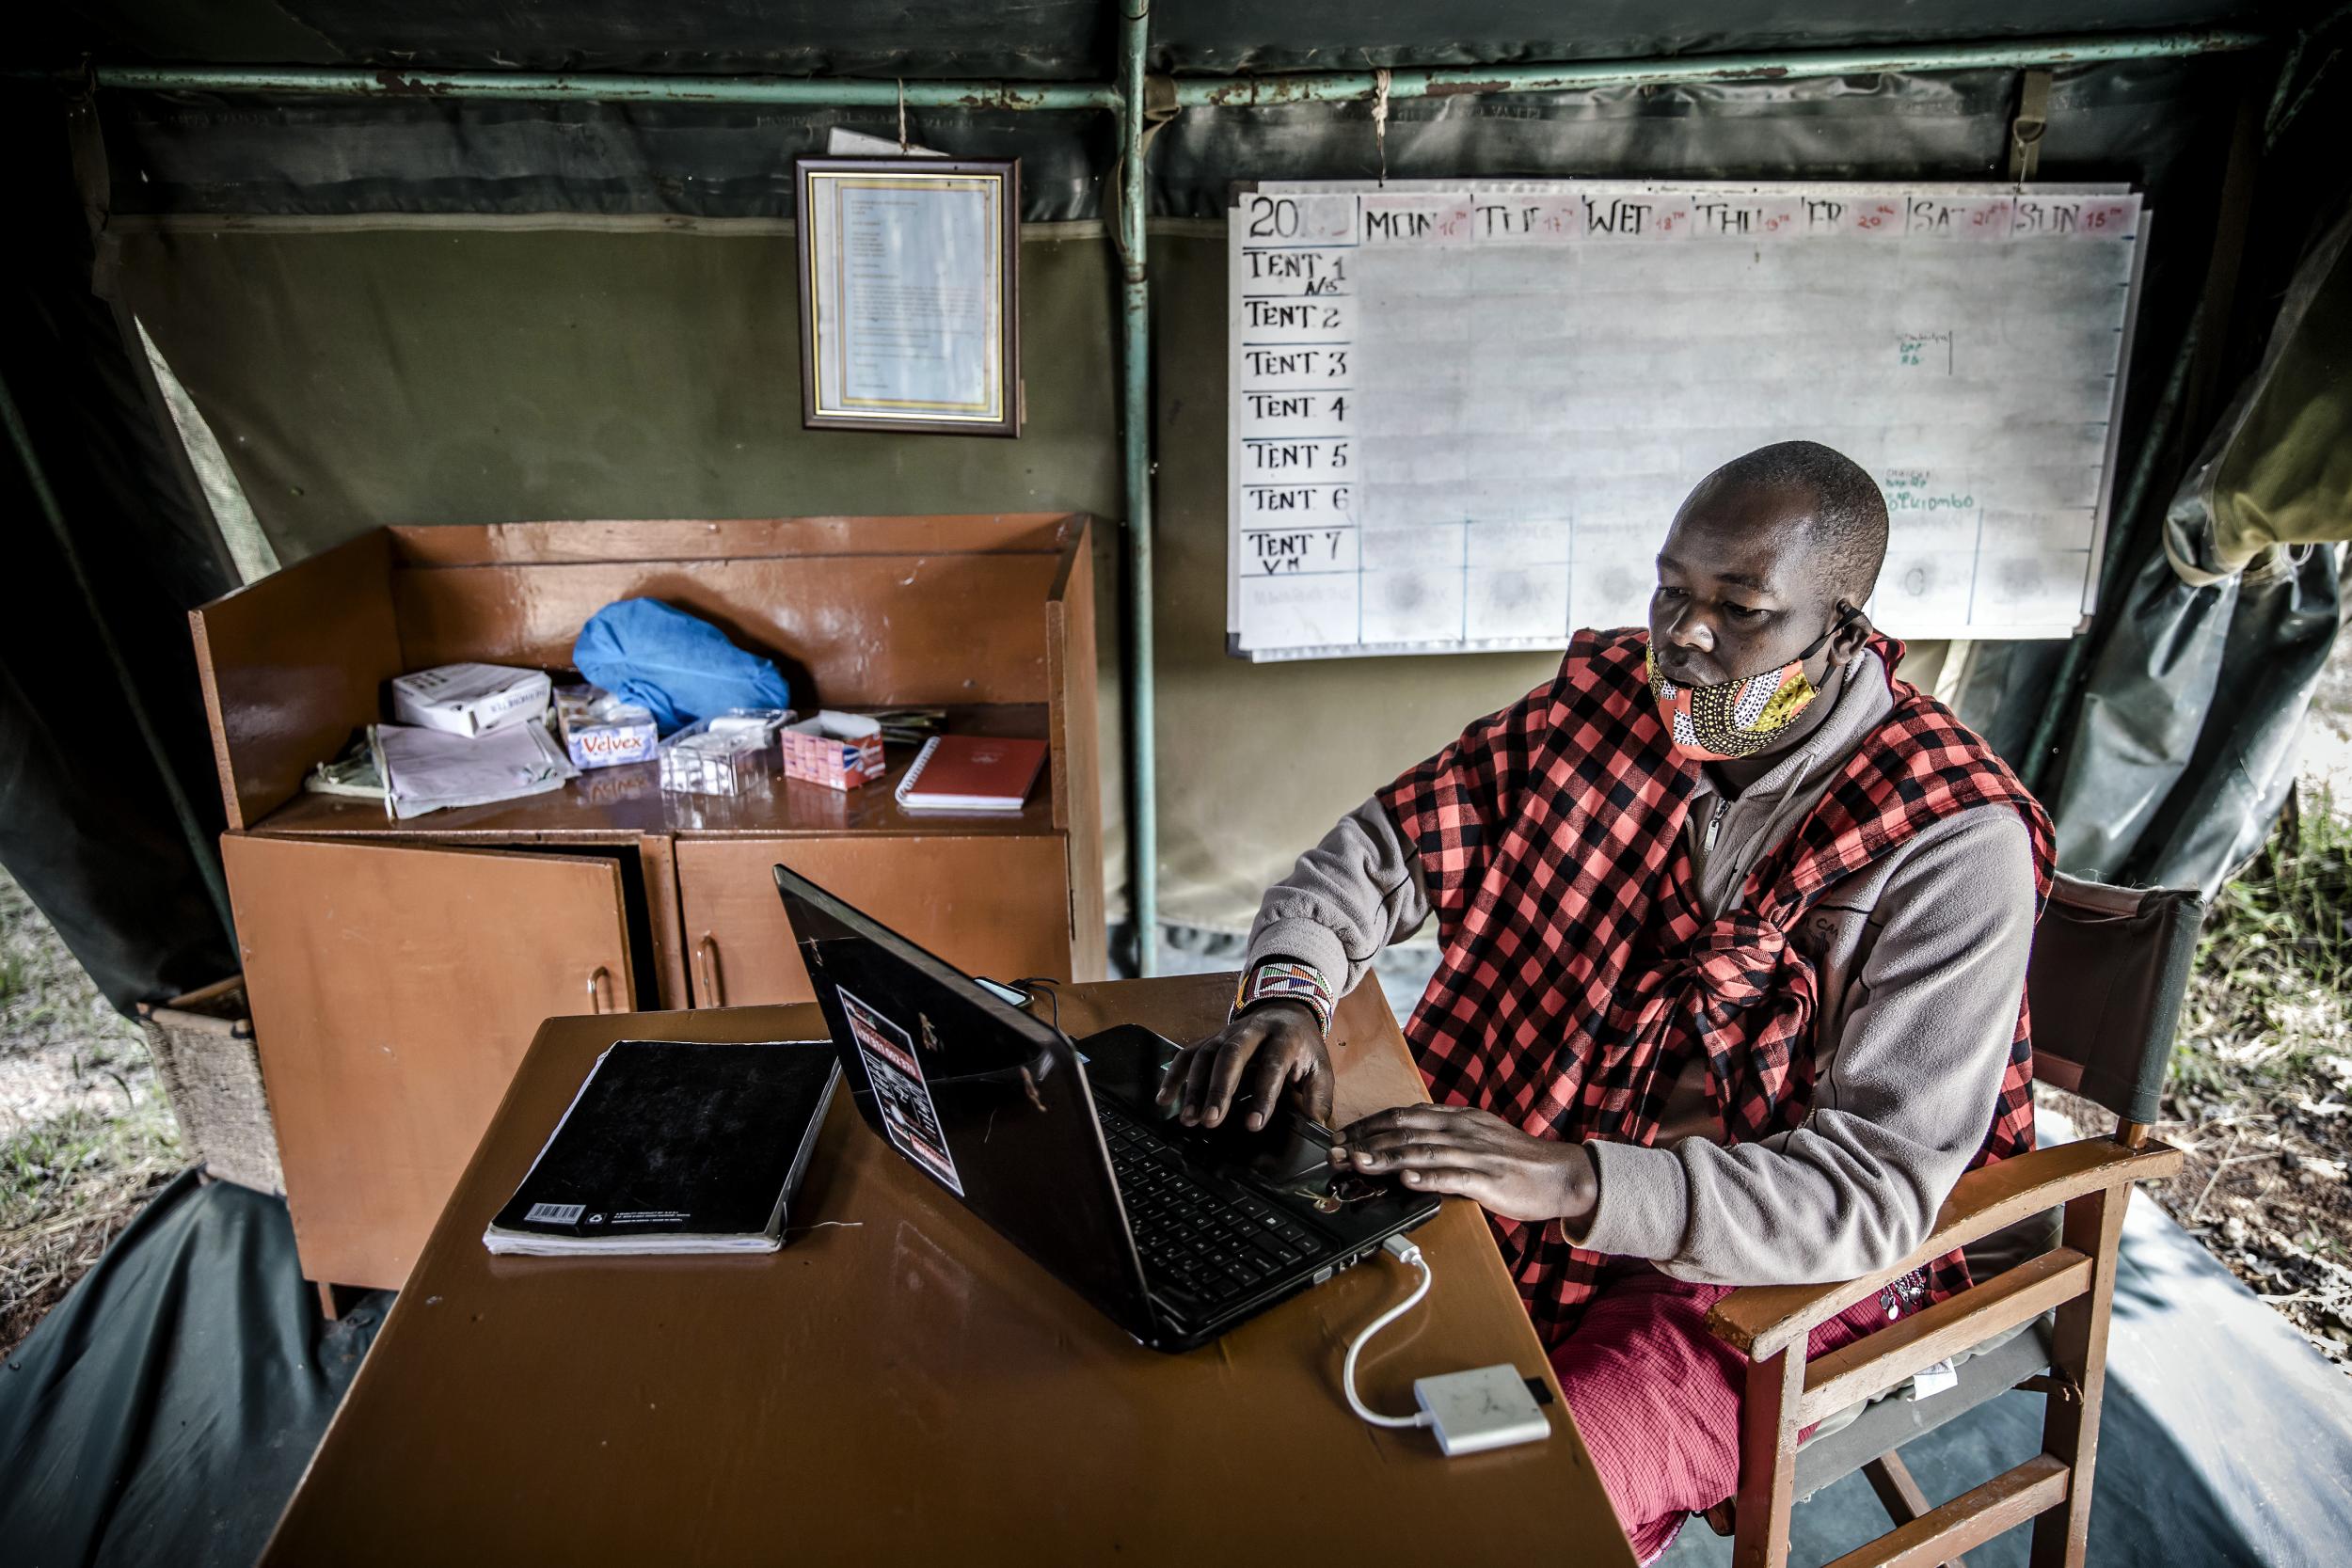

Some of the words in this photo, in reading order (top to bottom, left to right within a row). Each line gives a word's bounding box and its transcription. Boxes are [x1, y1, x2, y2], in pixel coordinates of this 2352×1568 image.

[1243, 251, 1322, 279] TENT
[1332, 255, 1346, 280] 1
[1245, 300, 1317, 329] TENT
[1322, 308, 1342, 329] 2
[1246, 352, 1318, 377] TENT
[1328, 352, 1347, 377] 3
[1248, 395, 1315, 420] TENT
[1329, 396, 1349, 421] 4
[1248, 443, 1318, 468] TENT
[1331, 444, 1348, 468] 5
[1249, 489, 1317, 512] TENT
[1332, 488, 1348, 511] 6
[1248, 533, 1315, 558] TENT
[1326, 531, 1342, 561] 7
[582, 736, 642, 753] Velvex
